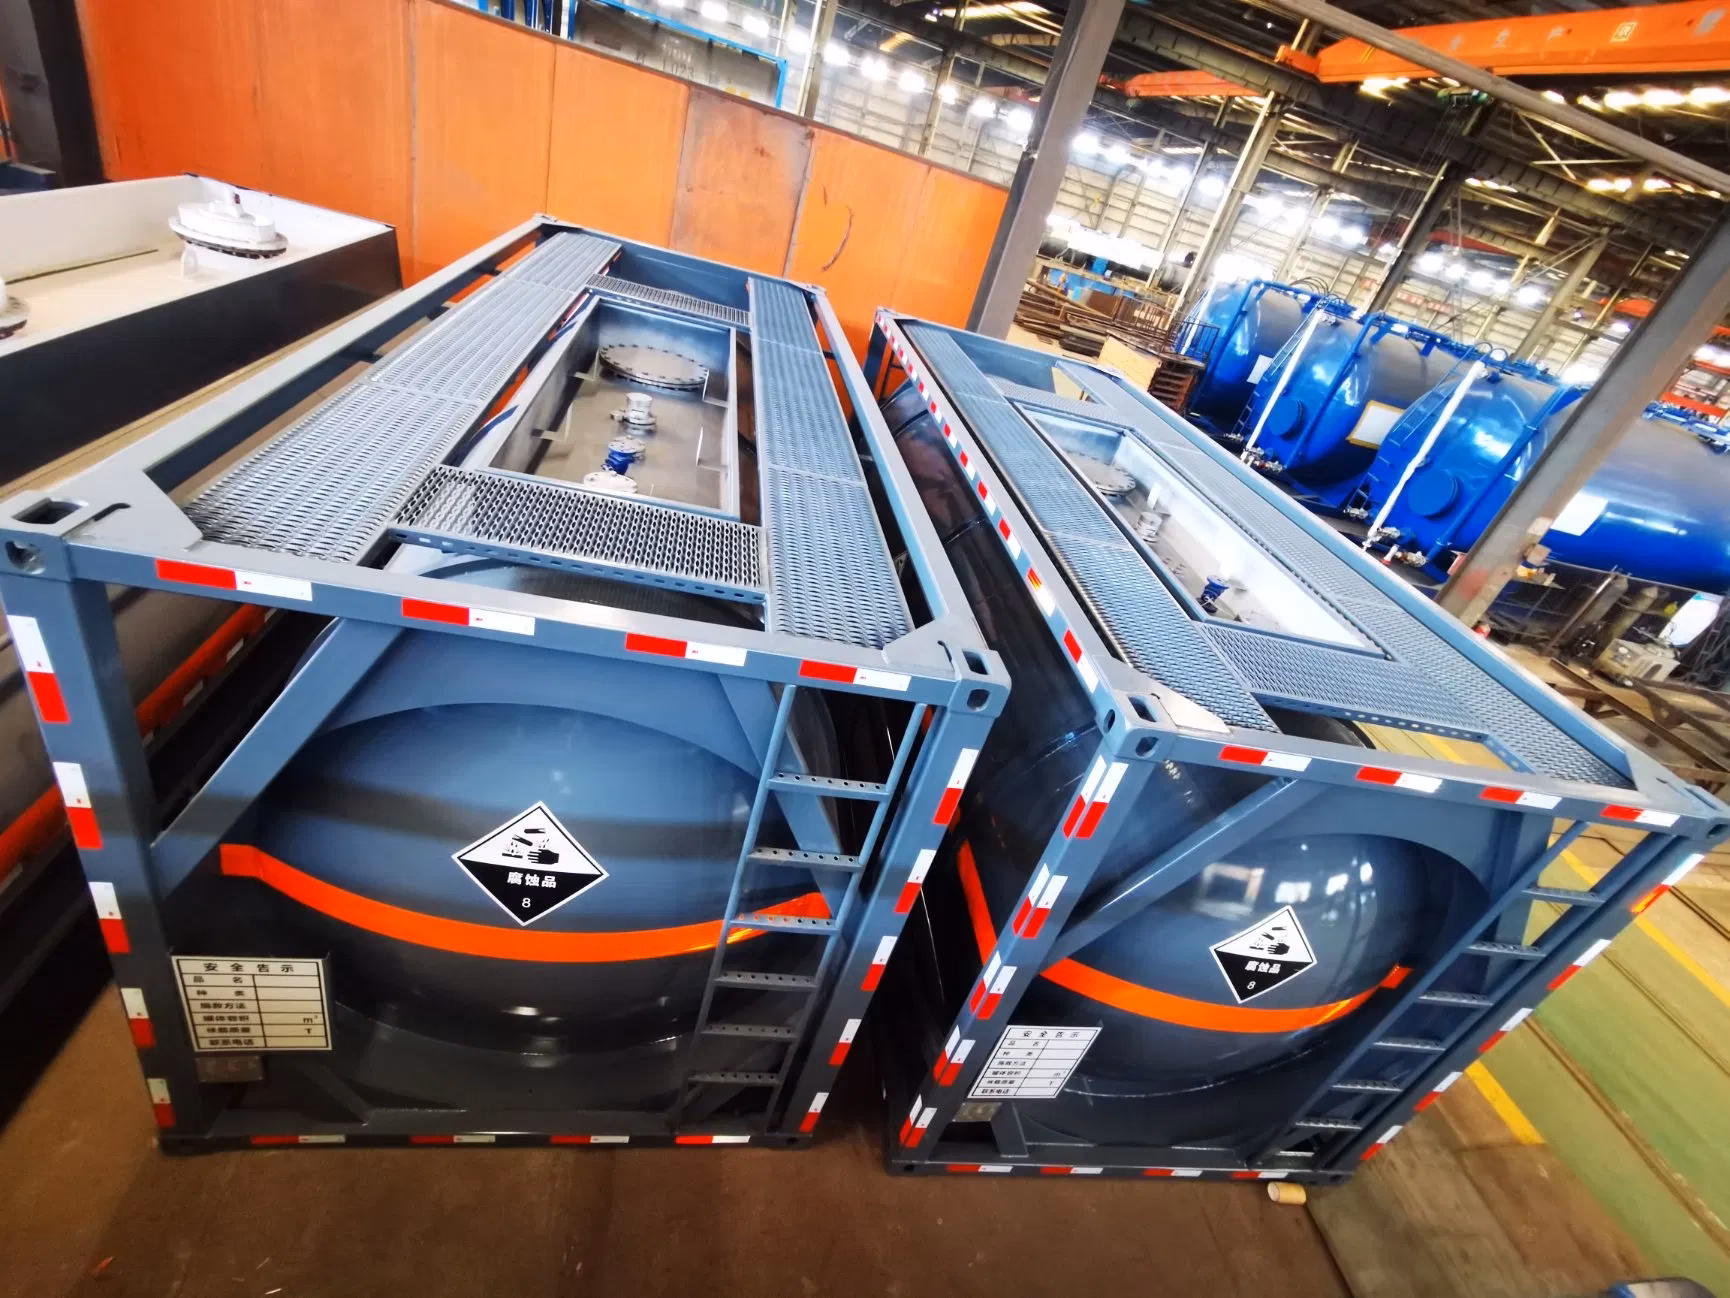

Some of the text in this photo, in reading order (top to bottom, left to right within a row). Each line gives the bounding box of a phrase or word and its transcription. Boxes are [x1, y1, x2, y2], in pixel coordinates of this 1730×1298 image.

[507, 872, 556, 888] 腐蚀品
[522, 897, 531, 908] 8
[203, 962, 295, 973] 安全告示
[1244, 961, 1281, 974] 腐蚀品
[1247, 981, 1256, 990] 8
[1022, 1030, 1080, 1038] 安全告示
